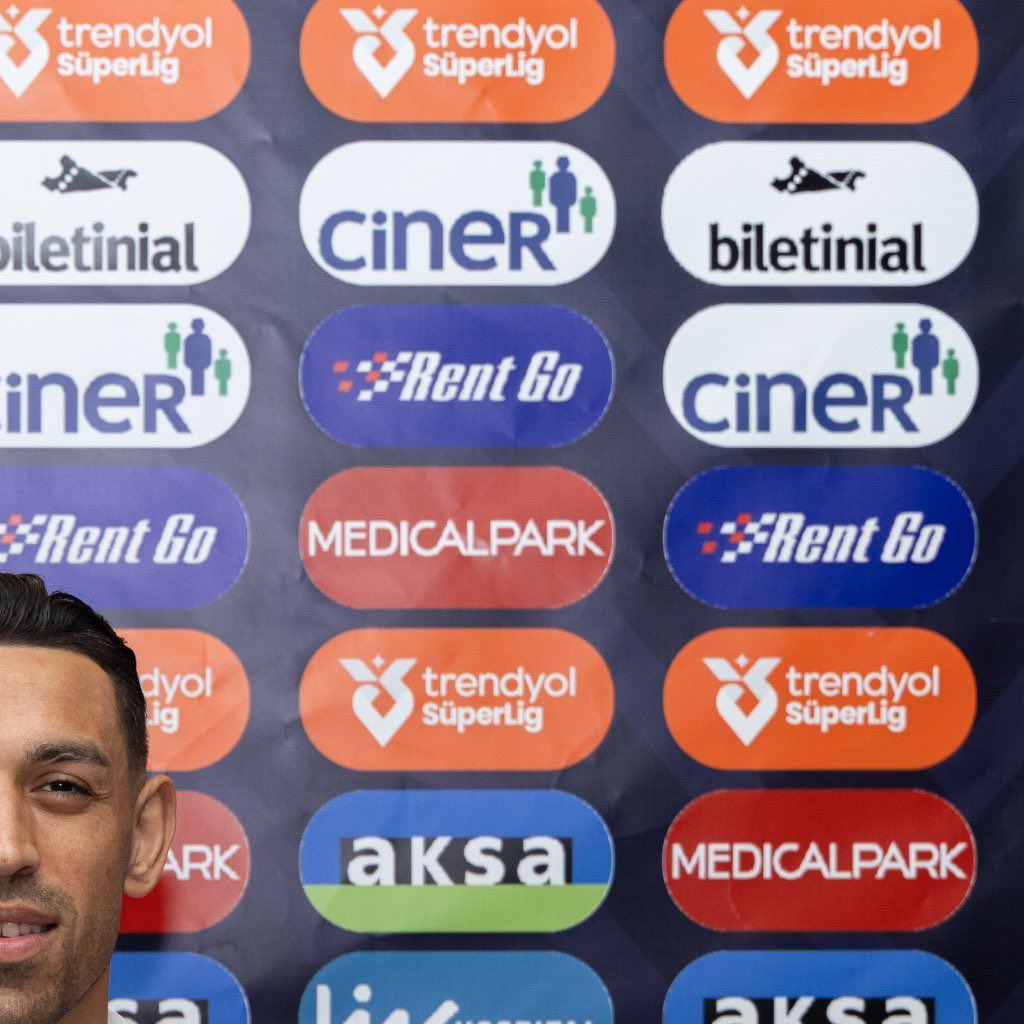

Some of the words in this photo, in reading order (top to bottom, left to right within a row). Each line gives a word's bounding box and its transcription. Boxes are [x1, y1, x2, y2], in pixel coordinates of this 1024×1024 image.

[56, 16, 213, 55] trendyol
[422, 17, 578, 56] trendyol
[786, 18, 942, 57] trendyol
[709, 222, 927, 273] biletinial
[399, 351, 516, 402] Rent
[518, 349, 583, 402] Go
[33, 514, 151, 564] Rent
[152, 513, 218, 564] Go
[307, 518, 605, 557] MEDICALPARK
[762, 512, 879, 564] Rent
[881, 511, 946, 564] Go
[139, 666, 213, 705] dyol
[421, 665, 577, 705] trendyol
[785, 665, 941, 704] trendyol
[671, 841, 967, 880] MEDICALPARK
